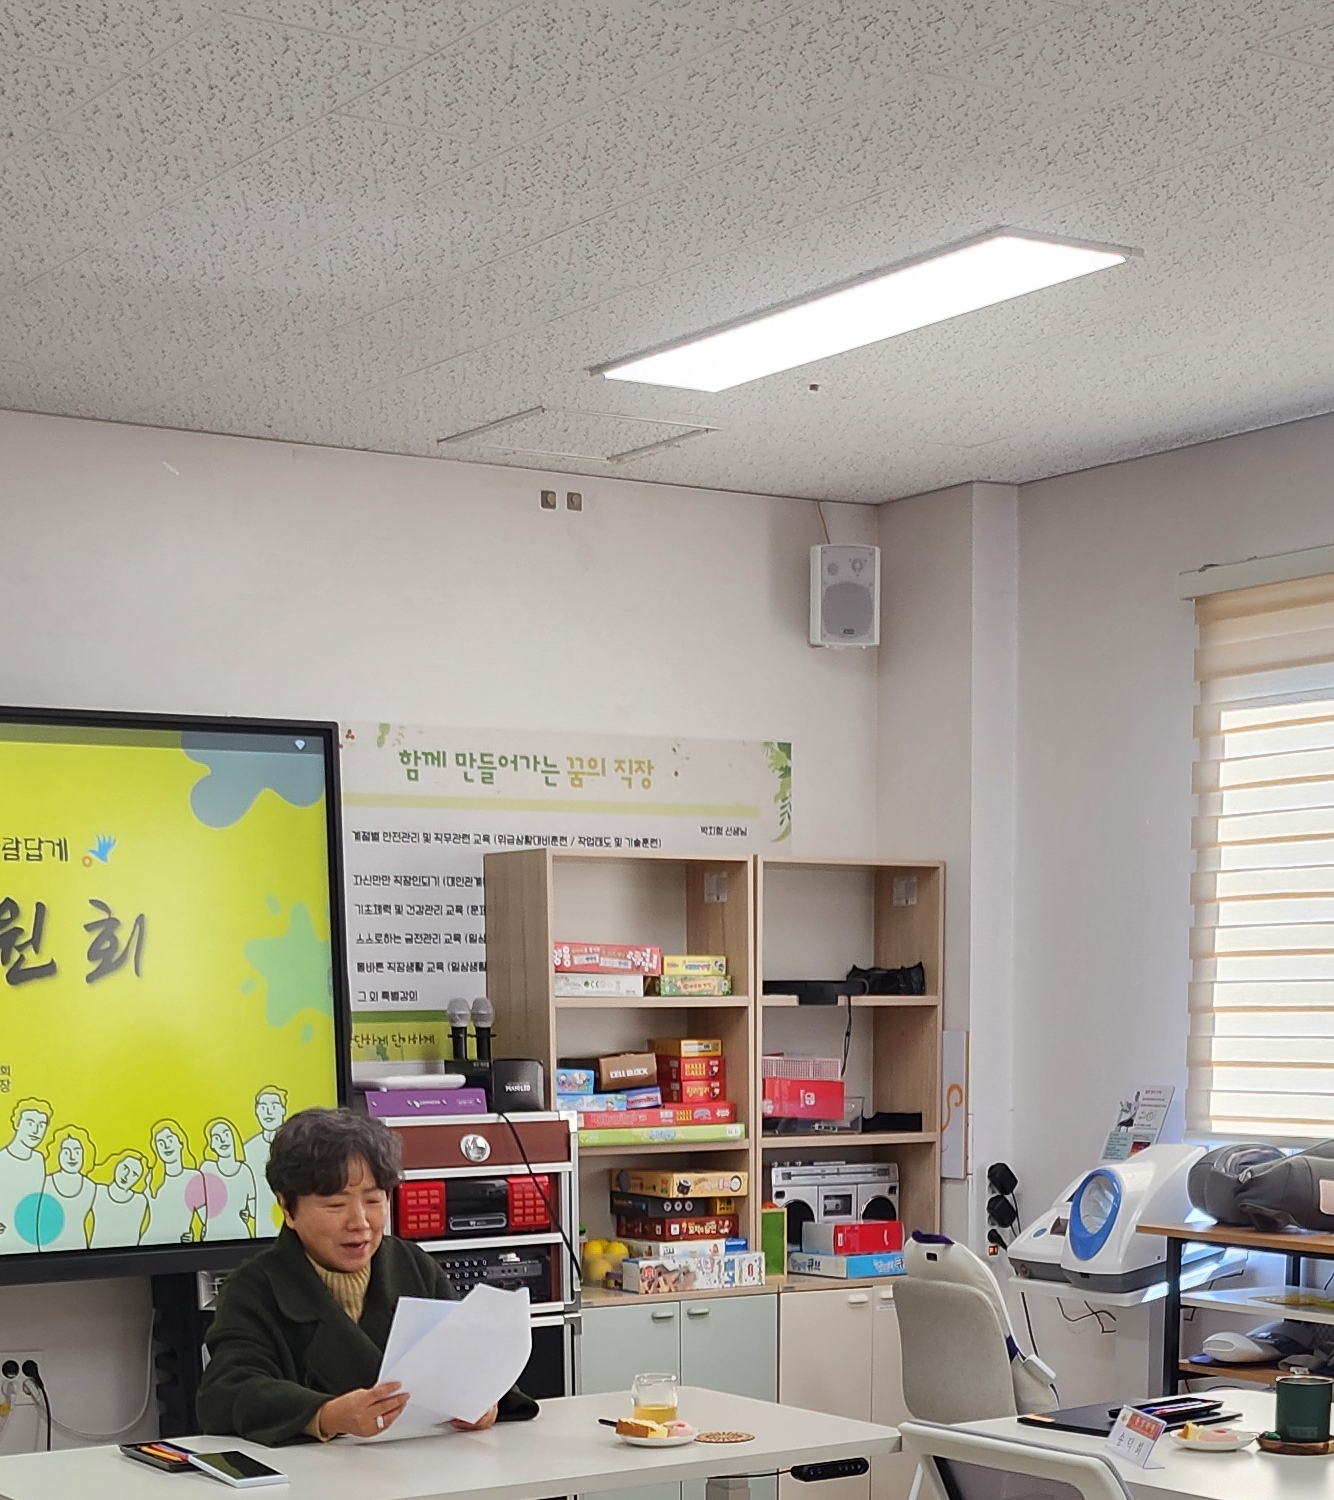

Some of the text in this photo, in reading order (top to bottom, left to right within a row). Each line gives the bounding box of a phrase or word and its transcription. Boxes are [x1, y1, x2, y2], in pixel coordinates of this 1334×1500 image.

[399, 750, 655, 791] 함께 만들어가는 꿈의 직장
[382, 831, 420, 843] 안전관리
[422, 832, 431, 843] 및
[434, 833, 471, 844] 직무관련
[473, 834, 491, 845] 교육
[614, 838, 623, 848] 및
[353, 874, 391, 886] 자신만만
[354, 904, 392, 916] 기초체력
[395, 904, 403, 916] 및
[406, 904, 443, 916] 건강관리
[446, 904, 464, 916] 교육
[356, 933, 402, 945] 스스로하는
[404, 933, 442, 945] 금전관리
[444, 933, 462, 945] 교육
[387, 962, 424, 973] 직장생활
[426, 962, 444, 973] 교육
[357, 991, 366, 1002] 그
[381, 990, 418, 1002] 특별강의
